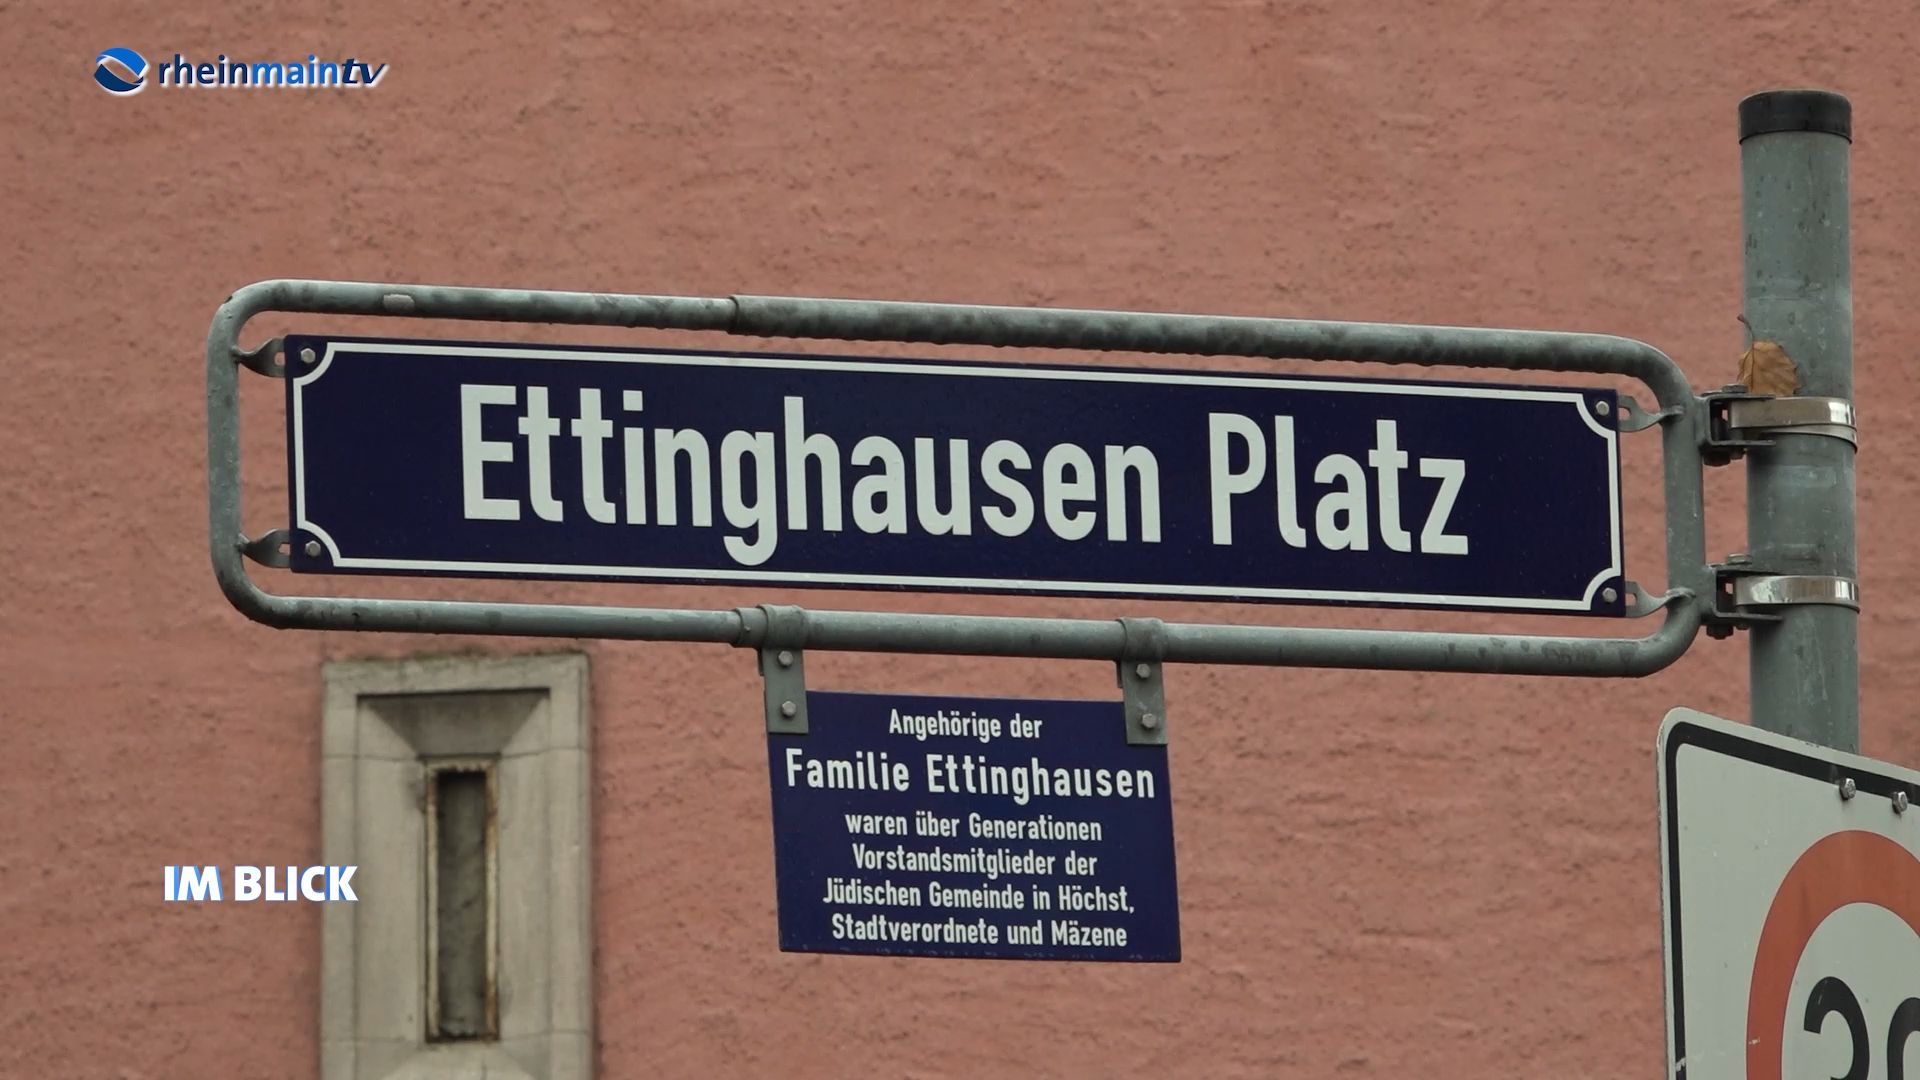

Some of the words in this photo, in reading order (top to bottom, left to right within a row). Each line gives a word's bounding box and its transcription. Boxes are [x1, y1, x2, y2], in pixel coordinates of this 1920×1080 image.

[460, 383, 1162, 566] Ettinghausen
[1208, 412, 1469, 556] Platz
[888, 708, 1002, 744] Angehörige
[1009, 712, 1043, 739] der
[785, 747, 910, 792] Familie
[926, 753, 1155, 806] Ettinghausen
[844, 813, 908, 837] waren
[915, 810, 961, 838] über
[968, 812, 1103, 842] Generationen
[852, 842, 1056, 881] Vorstandsmitglieder
[1064, 849, 1098, 876] der
[822, 877, 922, 908] Jüdischen
[928, 881, 1025, 911] Gemeinde
[1032, 883, 1051, 911] in
[1058, 884, 1135, 914] Höchst,
[831, 912, 999, 945] Stadtverordnete
[1006, 919, 1044, 946] und
[1050, 919, 1128, 948] Mäzene
